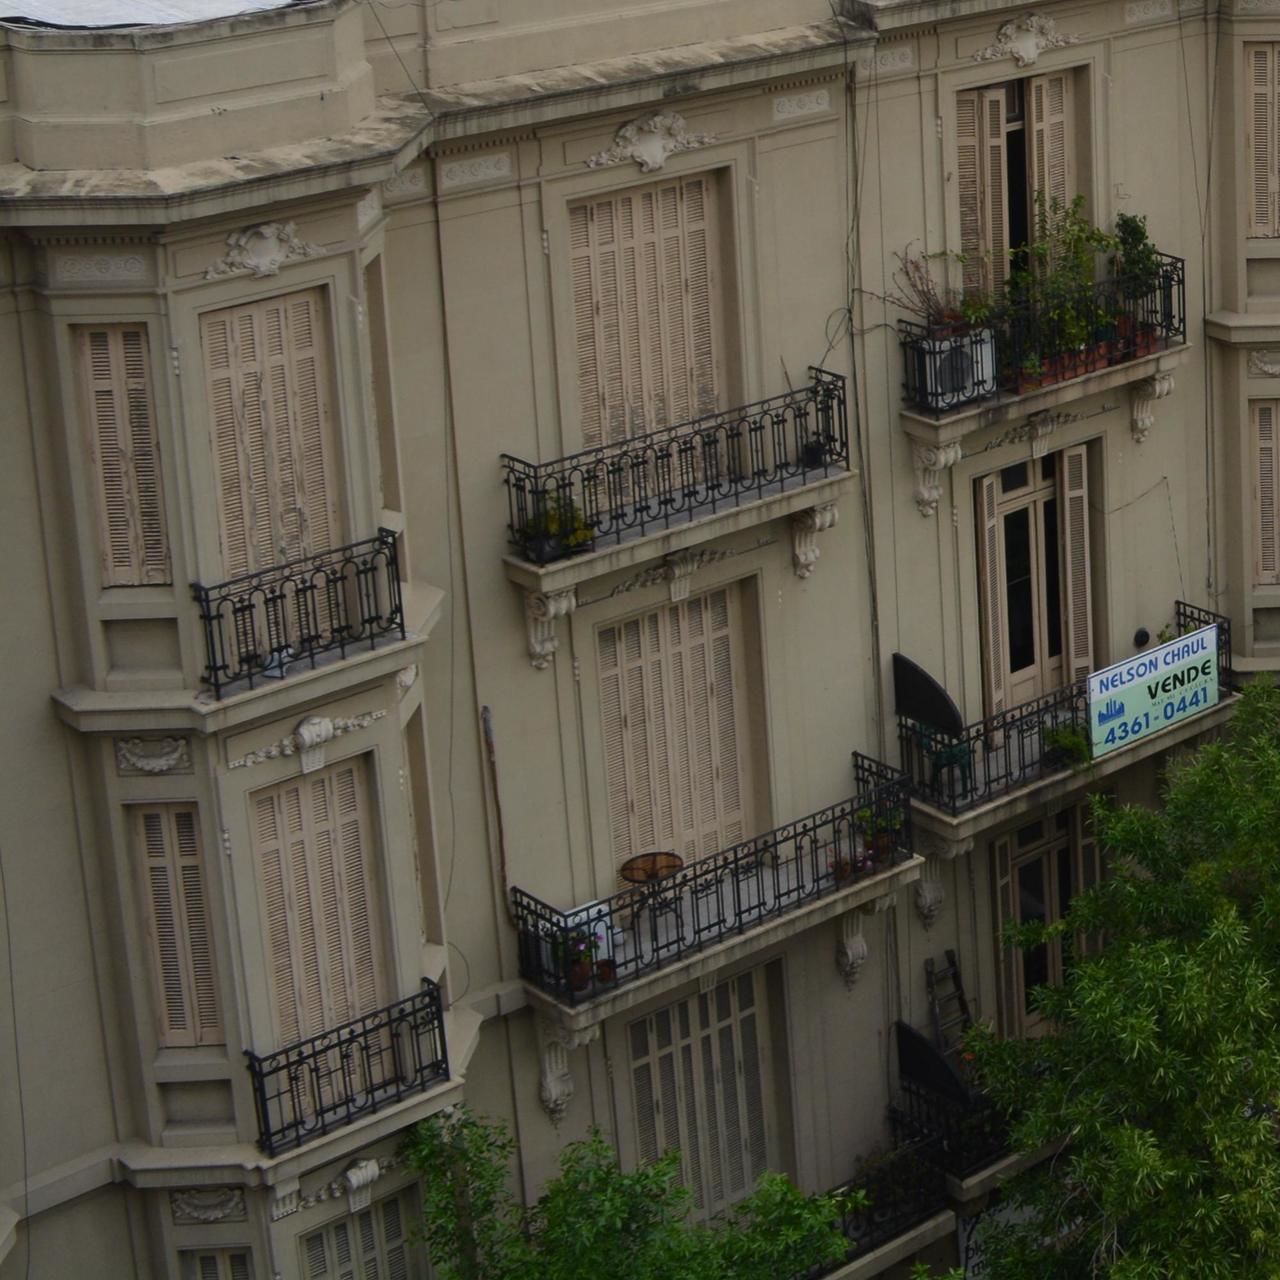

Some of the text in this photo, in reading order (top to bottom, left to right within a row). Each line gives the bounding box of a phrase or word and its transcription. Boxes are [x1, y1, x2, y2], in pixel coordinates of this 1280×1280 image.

[1099, 657, 1158, 694] NELSON
[1163, 637, 1207, 666] CHAUL
[1147, 659, 1212, 700] VENDE
[1104, 687, 1209, 745] 4361-0441
